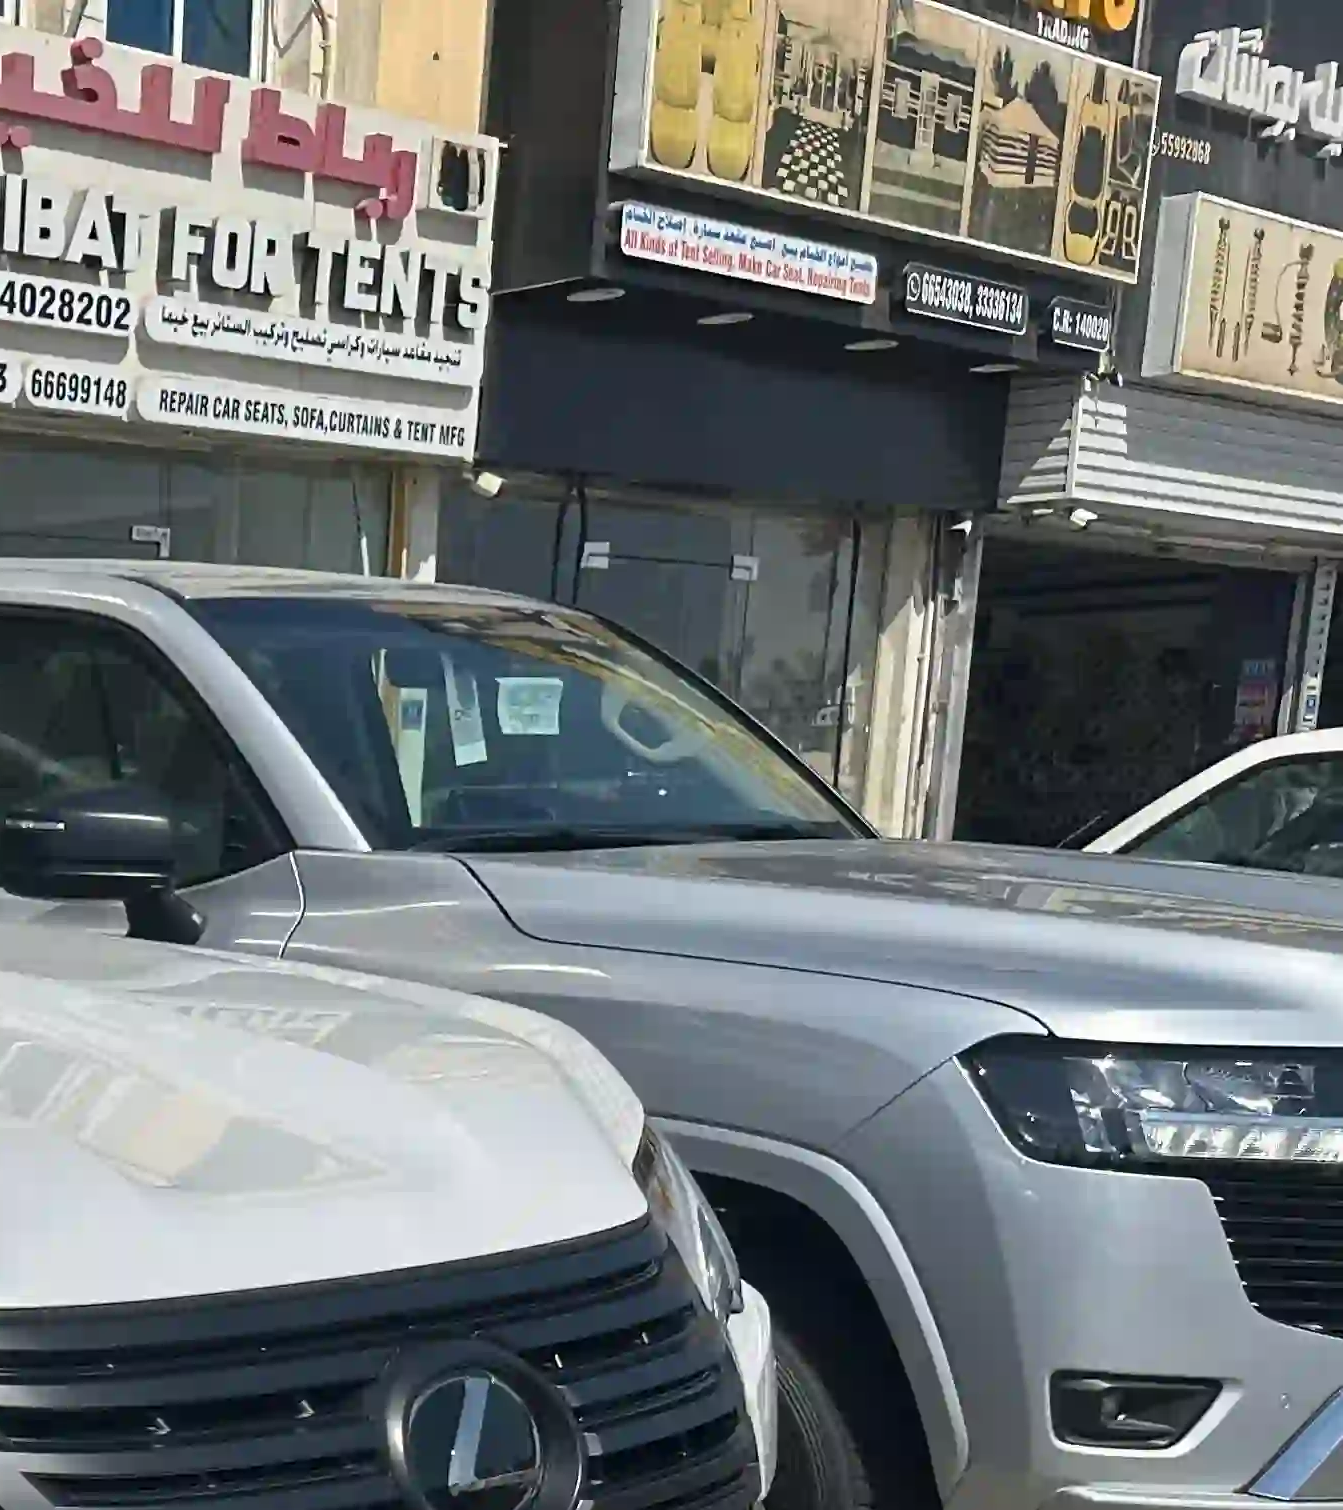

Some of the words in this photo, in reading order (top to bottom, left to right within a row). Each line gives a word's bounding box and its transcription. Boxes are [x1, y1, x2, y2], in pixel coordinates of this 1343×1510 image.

[1036, 11, 1091, 51] TRADING
[242, 88, 418, 220] رباط
[170, 206, 298, 299] FOR
[307, 228, 493, 332] TENTS
[765, 259, 781, 279] Car
[30, 368, 128, 410] 66699148
[159, 388, 209, 417] REPAIR
[212, 395, 240, 421] CAR
[244, 398, 289, 428] SEATS,
[393, 421, 402, 439] &
[407, 420, 436, 443] TENT
[439, 424, 465, 447] MFG
